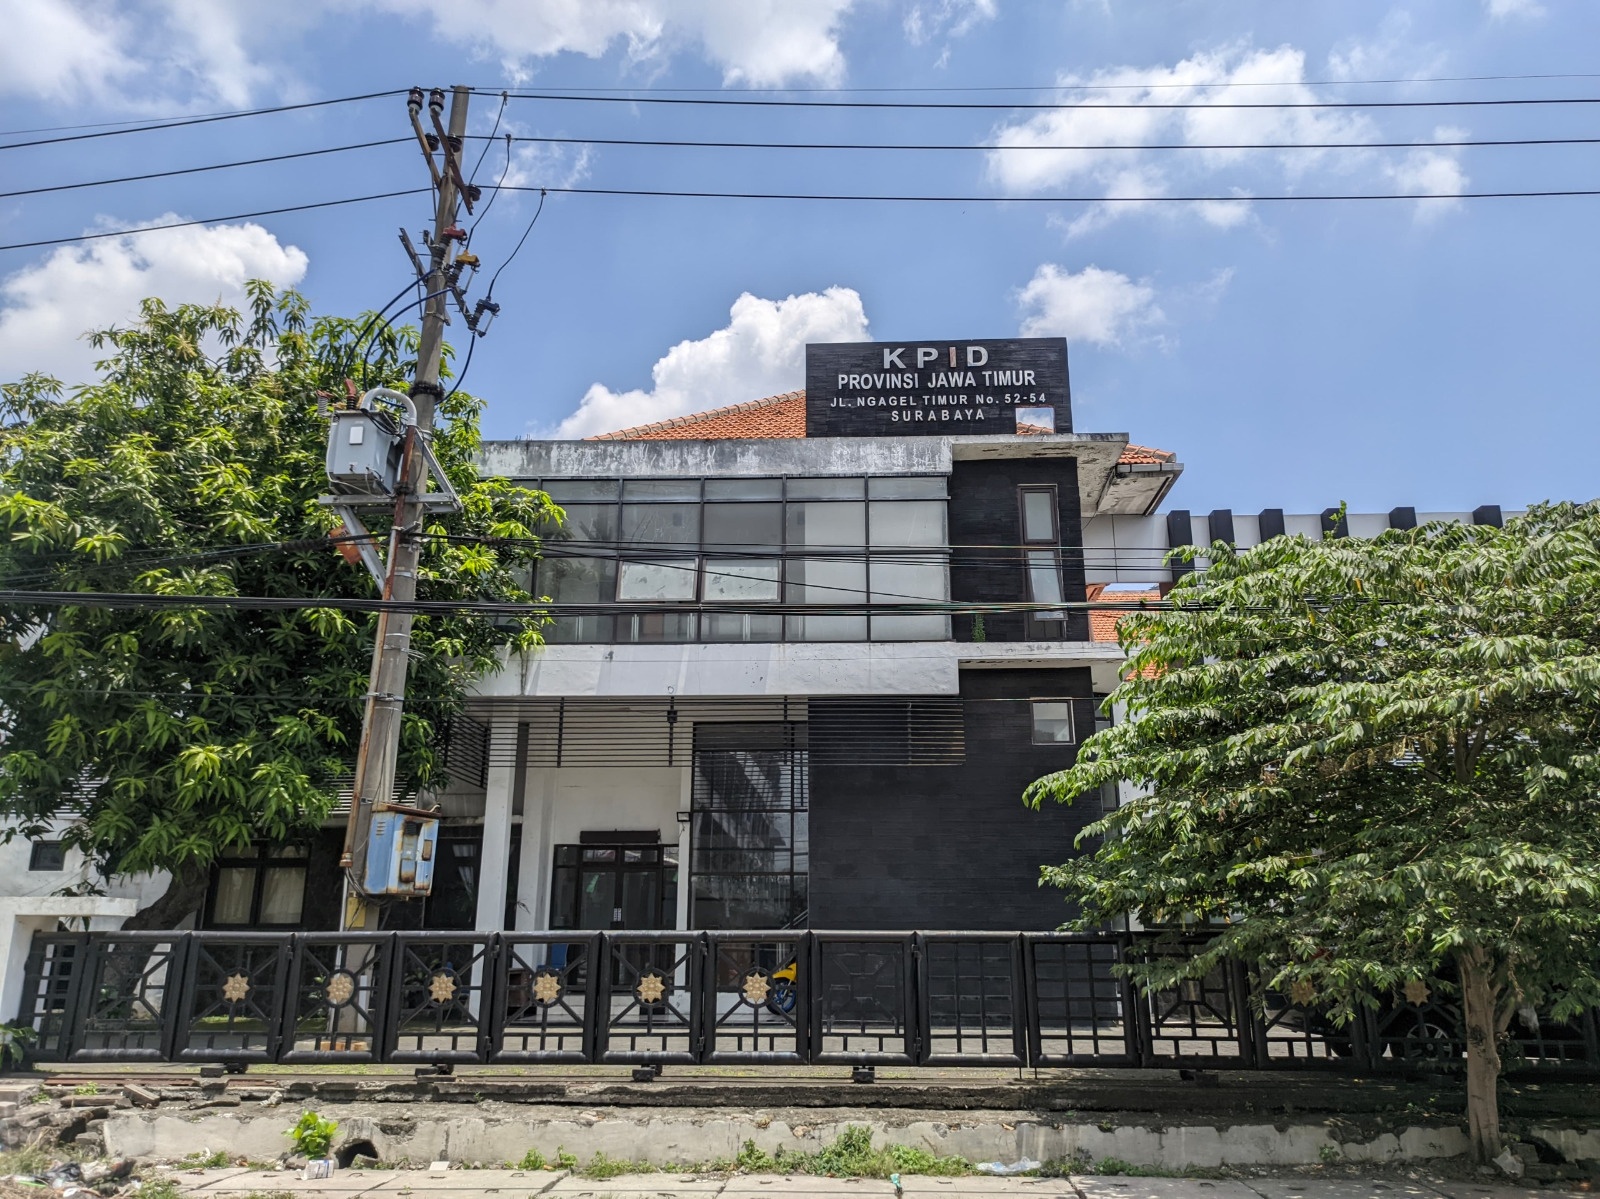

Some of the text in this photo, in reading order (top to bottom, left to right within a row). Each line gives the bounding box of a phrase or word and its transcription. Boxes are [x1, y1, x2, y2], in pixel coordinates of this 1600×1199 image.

[883, 346, 989, 369] KPID
[838, 370, 1037, 390] PROVINSI JAWA TIMUR
[830, 392, 1046, 408] JL. NGAGEL TIMUR No. 52-54
[891, 408, 985, 422] SURABAYA
